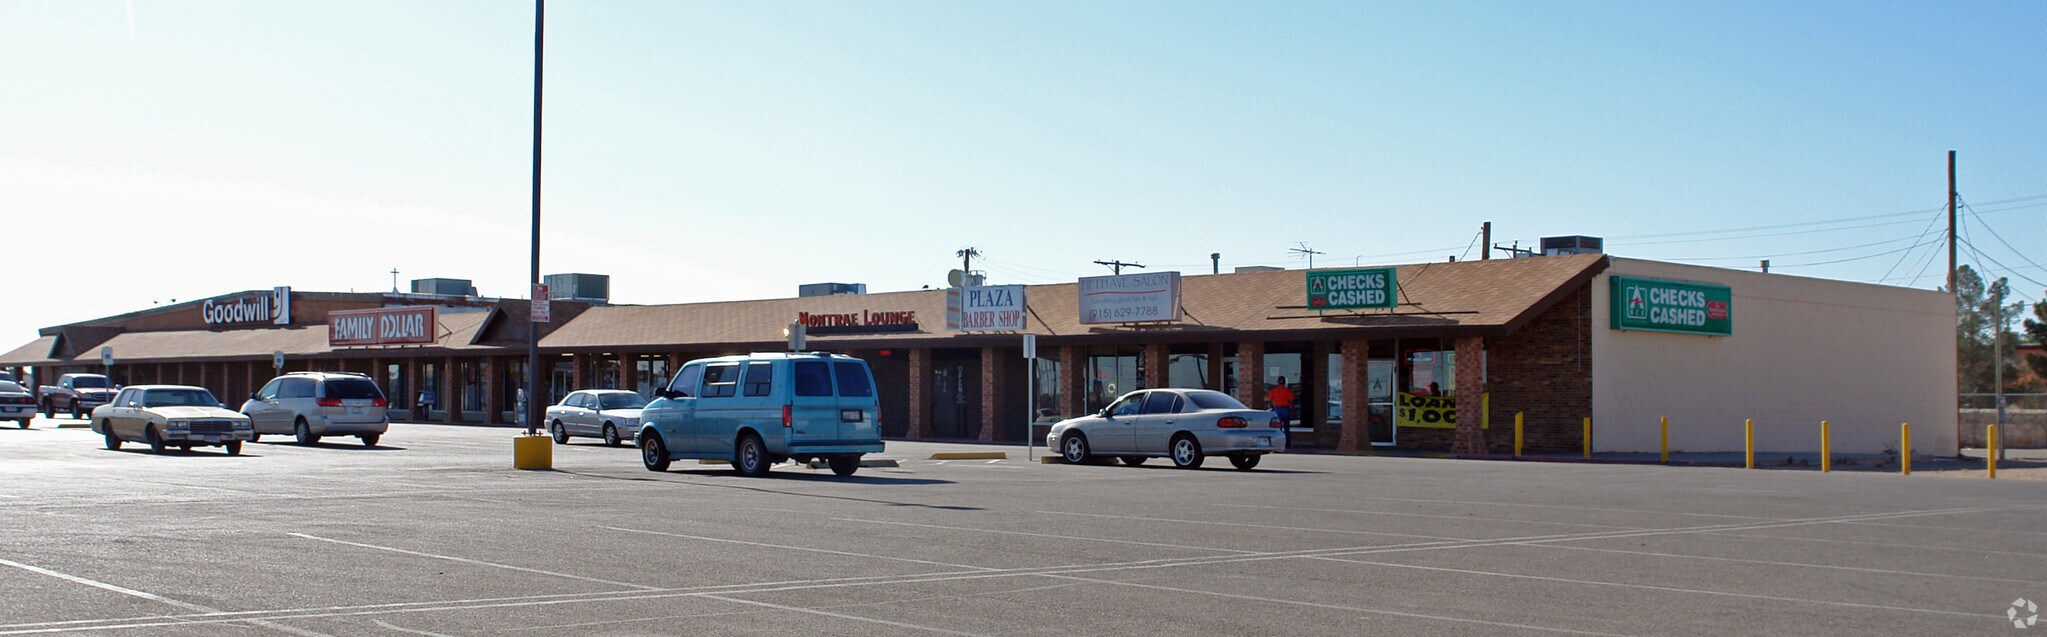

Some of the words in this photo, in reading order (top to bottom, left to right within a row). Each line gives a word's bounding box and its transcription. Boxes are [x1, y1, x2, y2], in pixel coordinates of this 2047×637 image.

[1109, 277, 1128, 289] AVE
[1132, 274, 1169, 287] SALON
[1327, 273, 1385, 290] CHECKS
[969, 288, 1014, 308] PLAZA
[1328, 290, 1386, 305] CASHED
[1650, 287, 1706, 308] CHECKS
[203, 296, 269, 324] Goodwill
[799, 311, 859, 328] MONTRAE
[863, 309, 915, 325] LOUNGE
[963, 311, 995, 328] BARBER
[998, 310, 1020, 327] SHOP
[1089, 308, 1112, 320] (915)
[1114, 306, 1158, 318] 629-7788
[1650, 306, 1706, 326] CASHED
[334, 316, 374, 340] FAMILY
[380, 313, 425, 339] DOLLAR
[1399, 408, 1456, 424] $1,00
